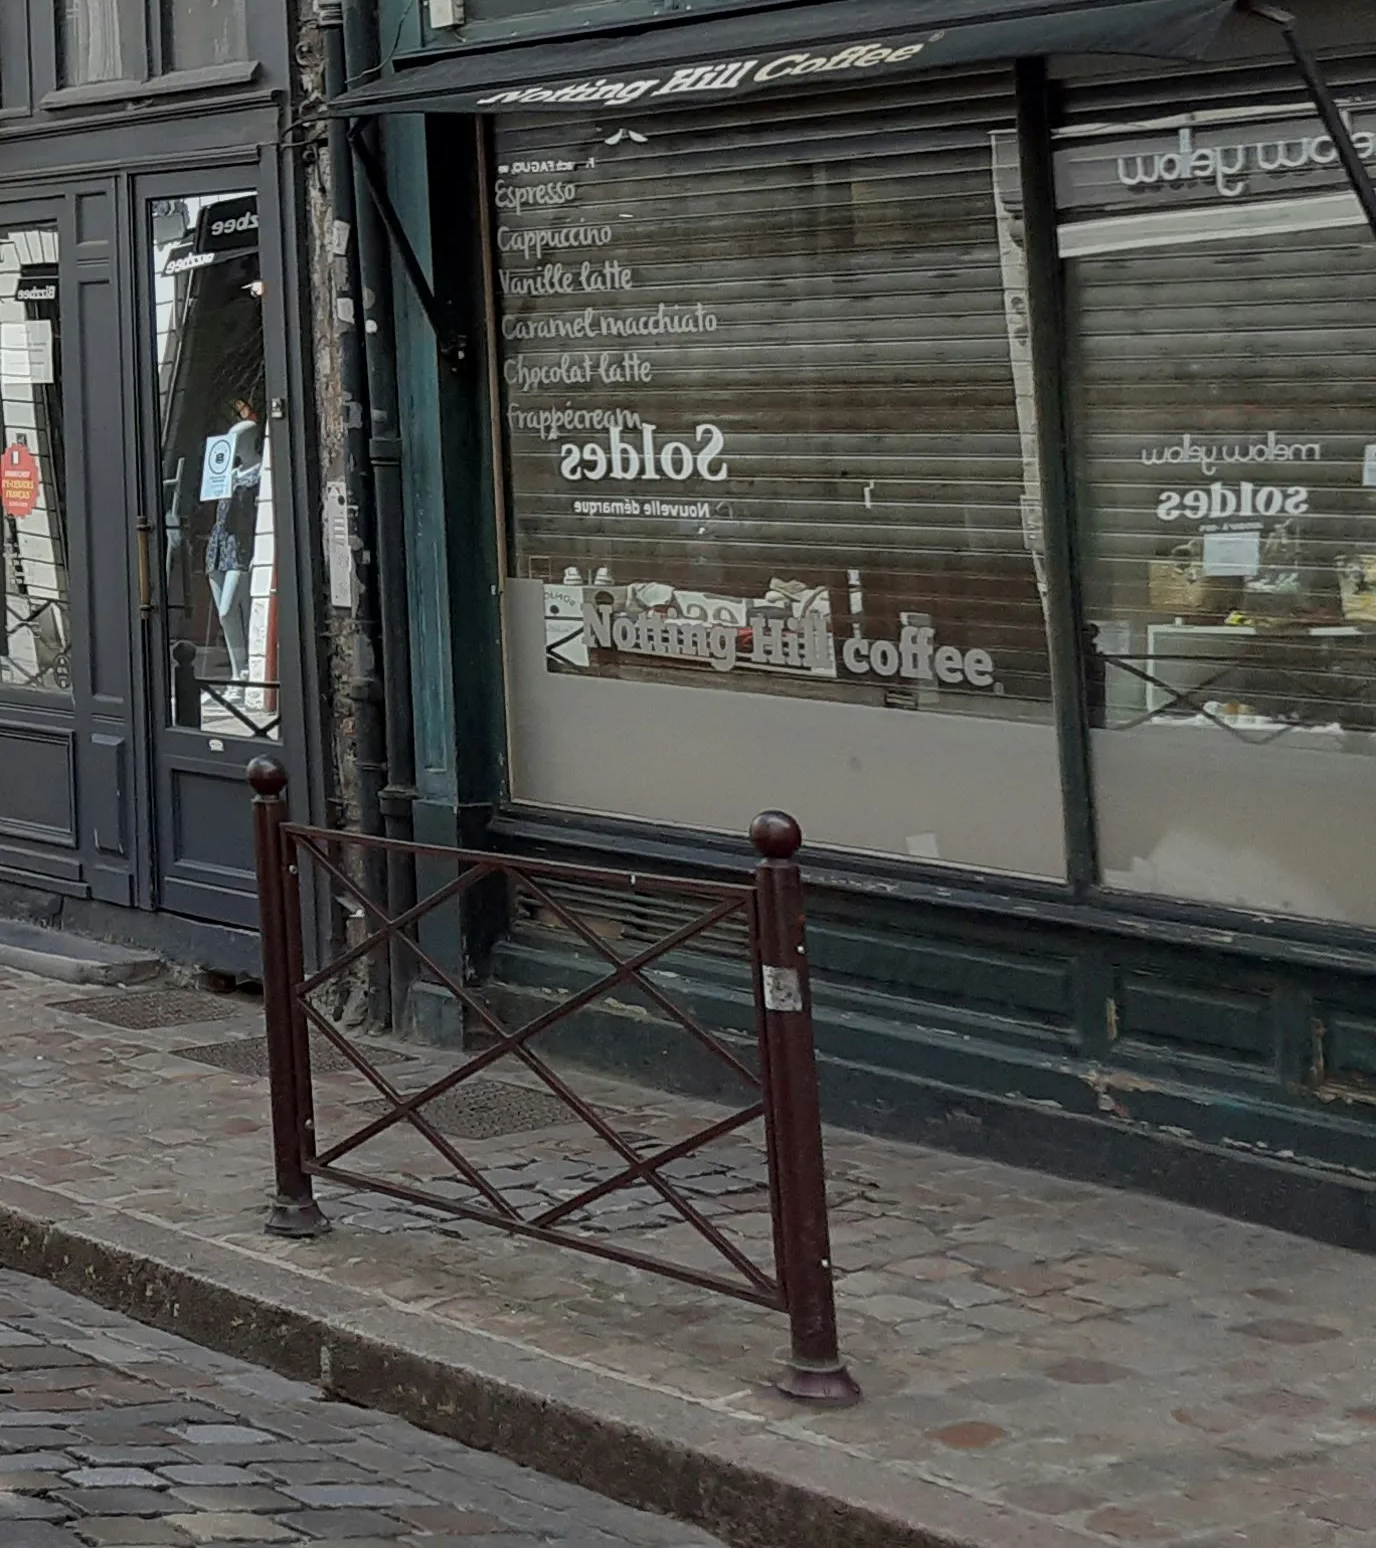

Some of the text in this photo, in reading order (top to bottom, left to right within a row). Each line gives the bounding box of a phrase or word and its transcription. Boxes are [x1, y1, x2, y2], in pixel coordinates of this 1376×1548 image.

[477, 41, 925, 106] Notting Hill Coffee
[494, 179, 575, 216] Espresso
[497, 226, 612, 260] Cappuccino
[498, 259, 634, 296] Vanille latte
[501, 302, 718, 341] Caramel macchiato
[502, 352, 653, 392] Chocolat latte
[583, 602, 996, 686] Notting Hill coffee
